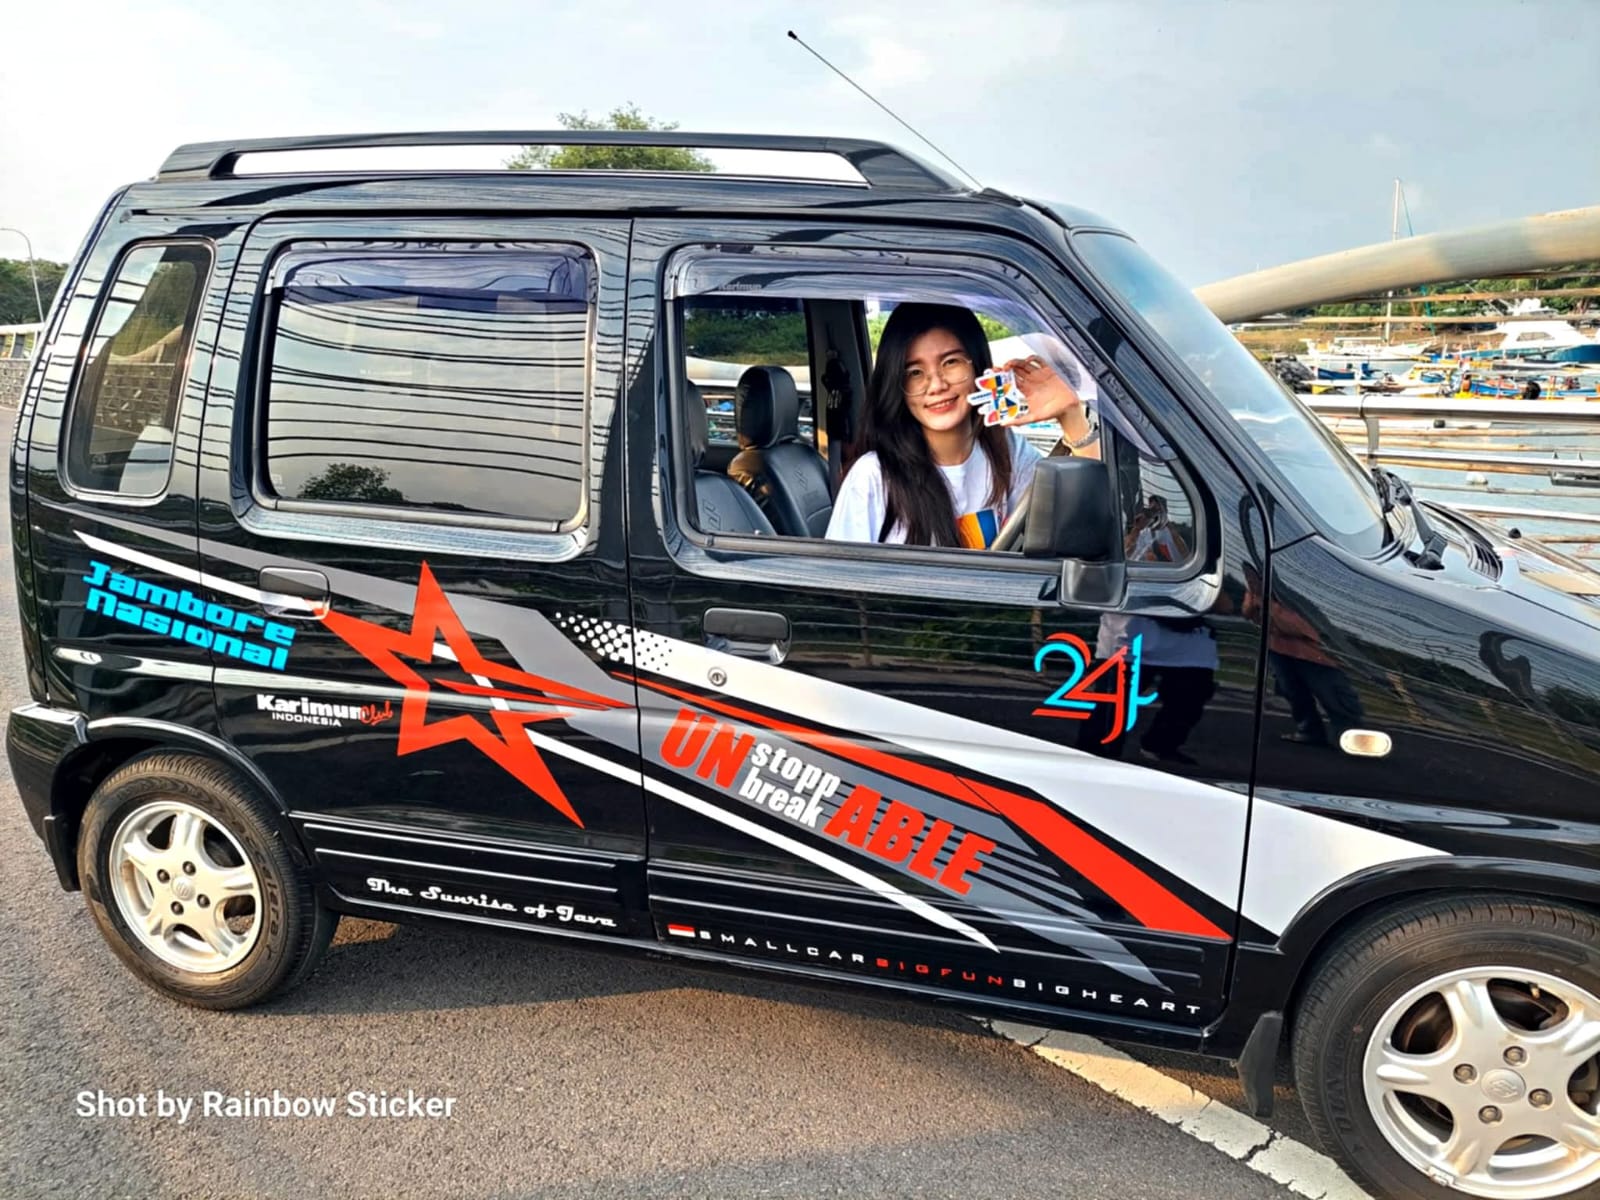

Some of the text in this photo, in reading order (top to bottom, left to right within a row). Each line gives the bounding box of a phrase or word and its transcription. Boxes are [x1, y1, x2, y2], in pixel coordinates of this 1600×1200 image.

[82, 559, 297, 647] Jambore
[256, 693, 394, 726] Karimun Club
[1031, 632, 1159, 745] 24
[272, 712, 342, 727] INDONESIA
[660, 707, 997, 895] UN stopp ABLE
[738, 767, 825, 828] break
[366, 877, 618, 927] The Sunrise of Java
